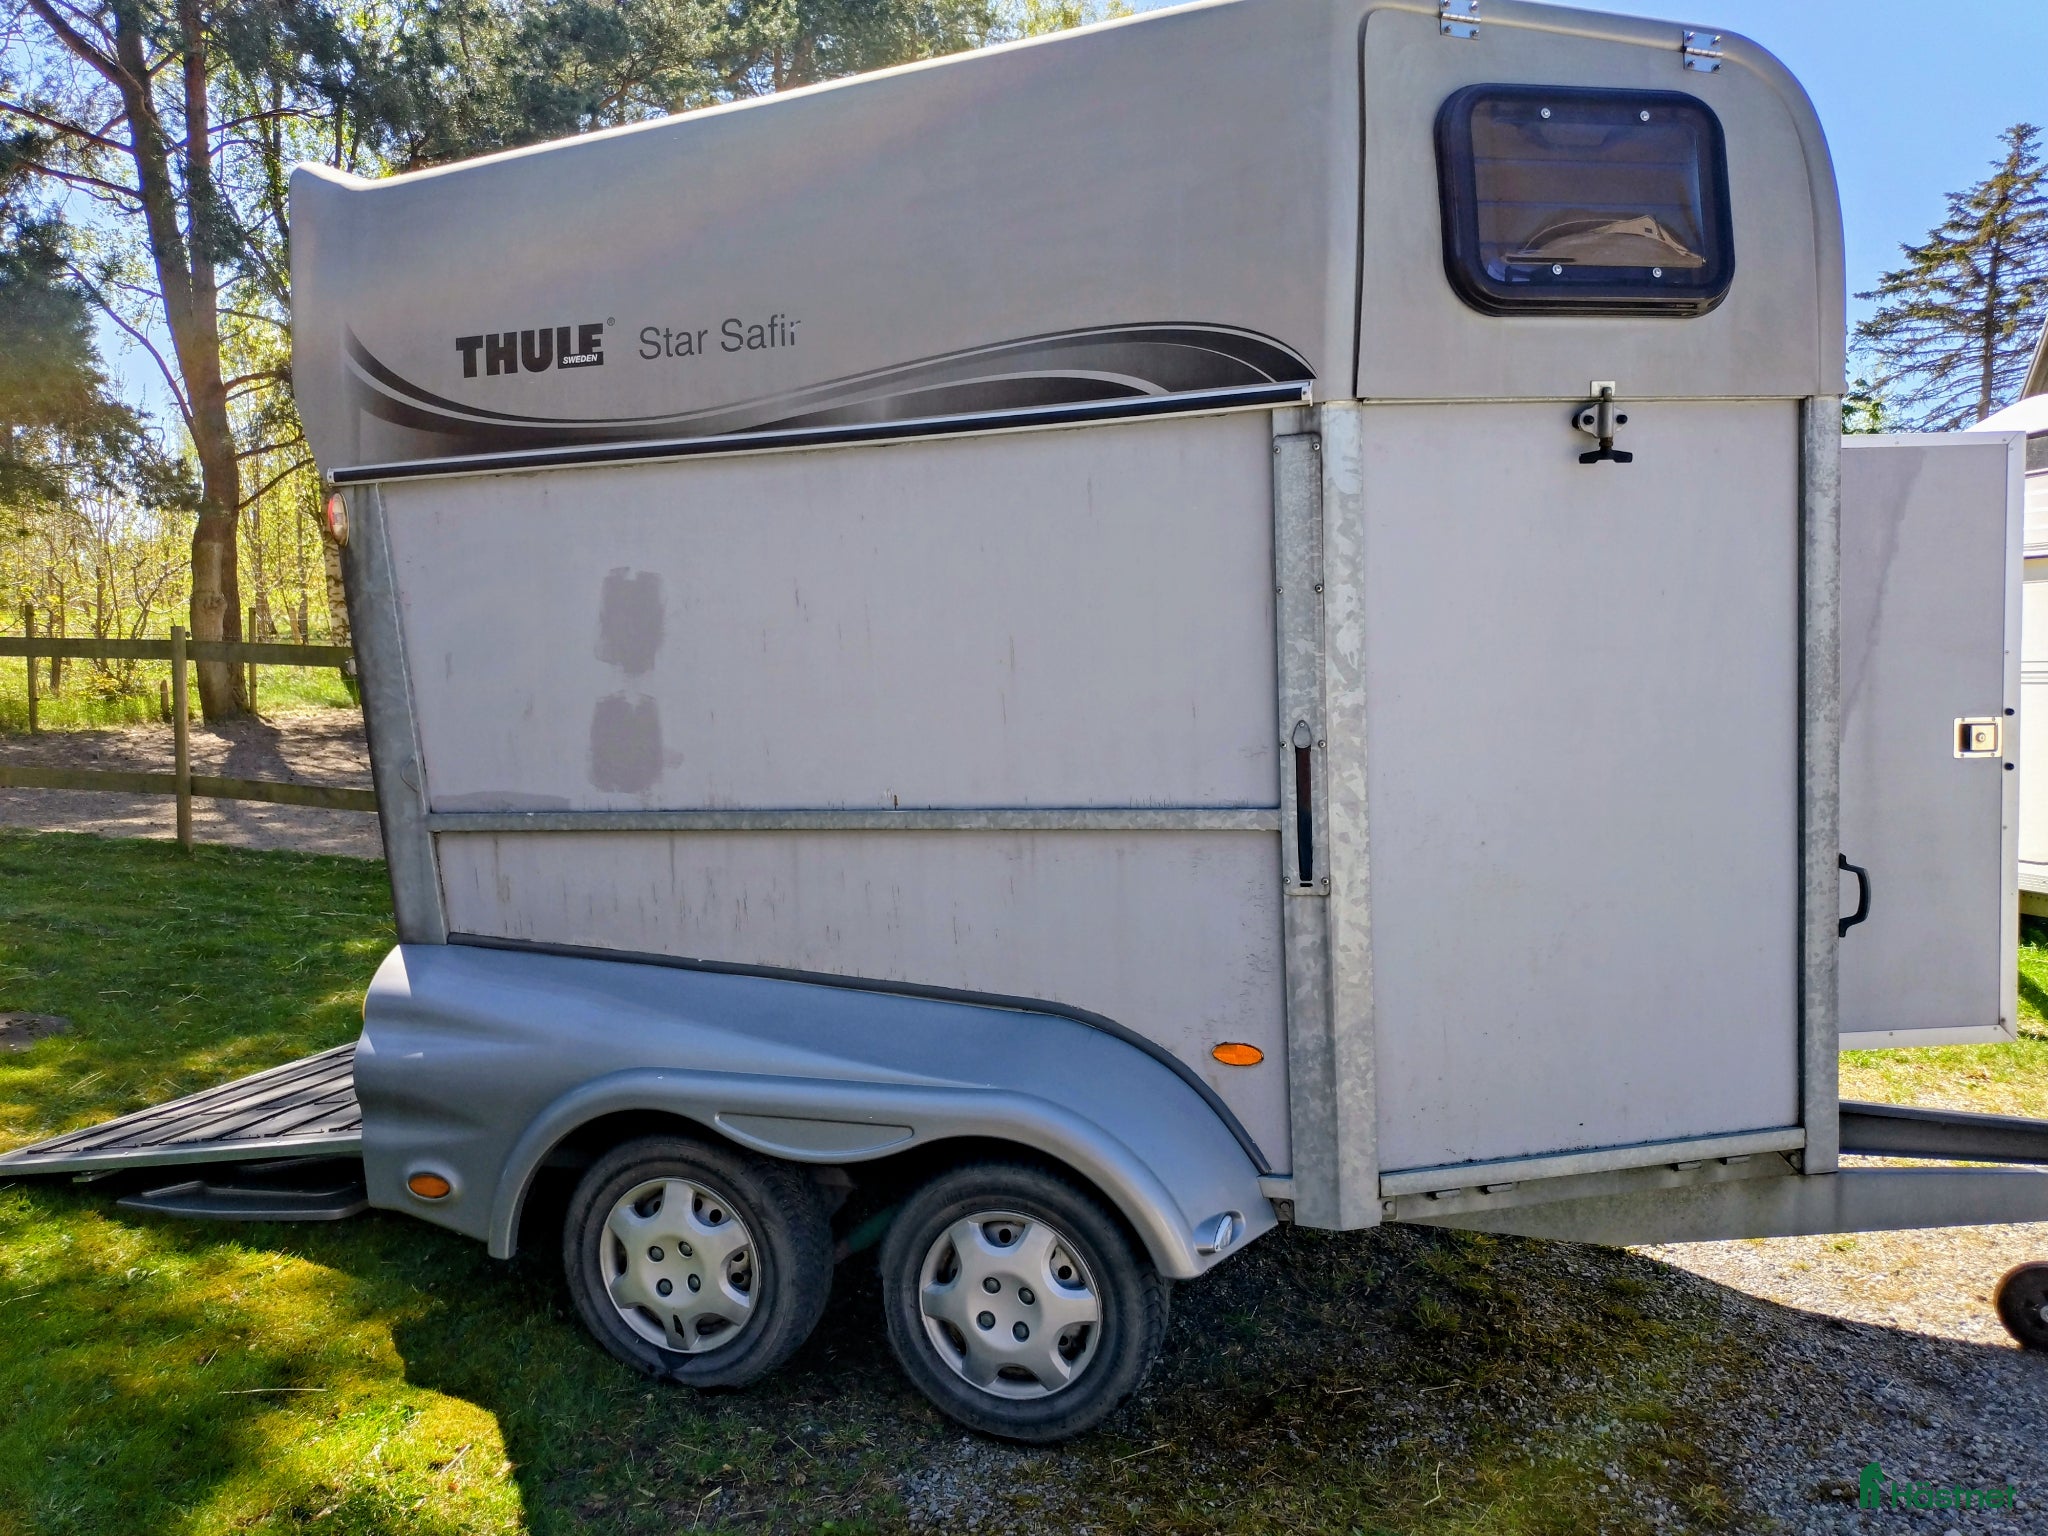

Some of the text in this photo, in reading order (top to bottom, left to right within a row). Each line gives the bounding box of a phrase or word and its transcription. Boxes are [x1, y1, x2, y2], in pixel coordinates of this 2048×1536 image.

[456, 322, 604, 378] THULE
[562, 353, 598, 365] SWEDEN
[639, 313, 802, 360] Star Safir
